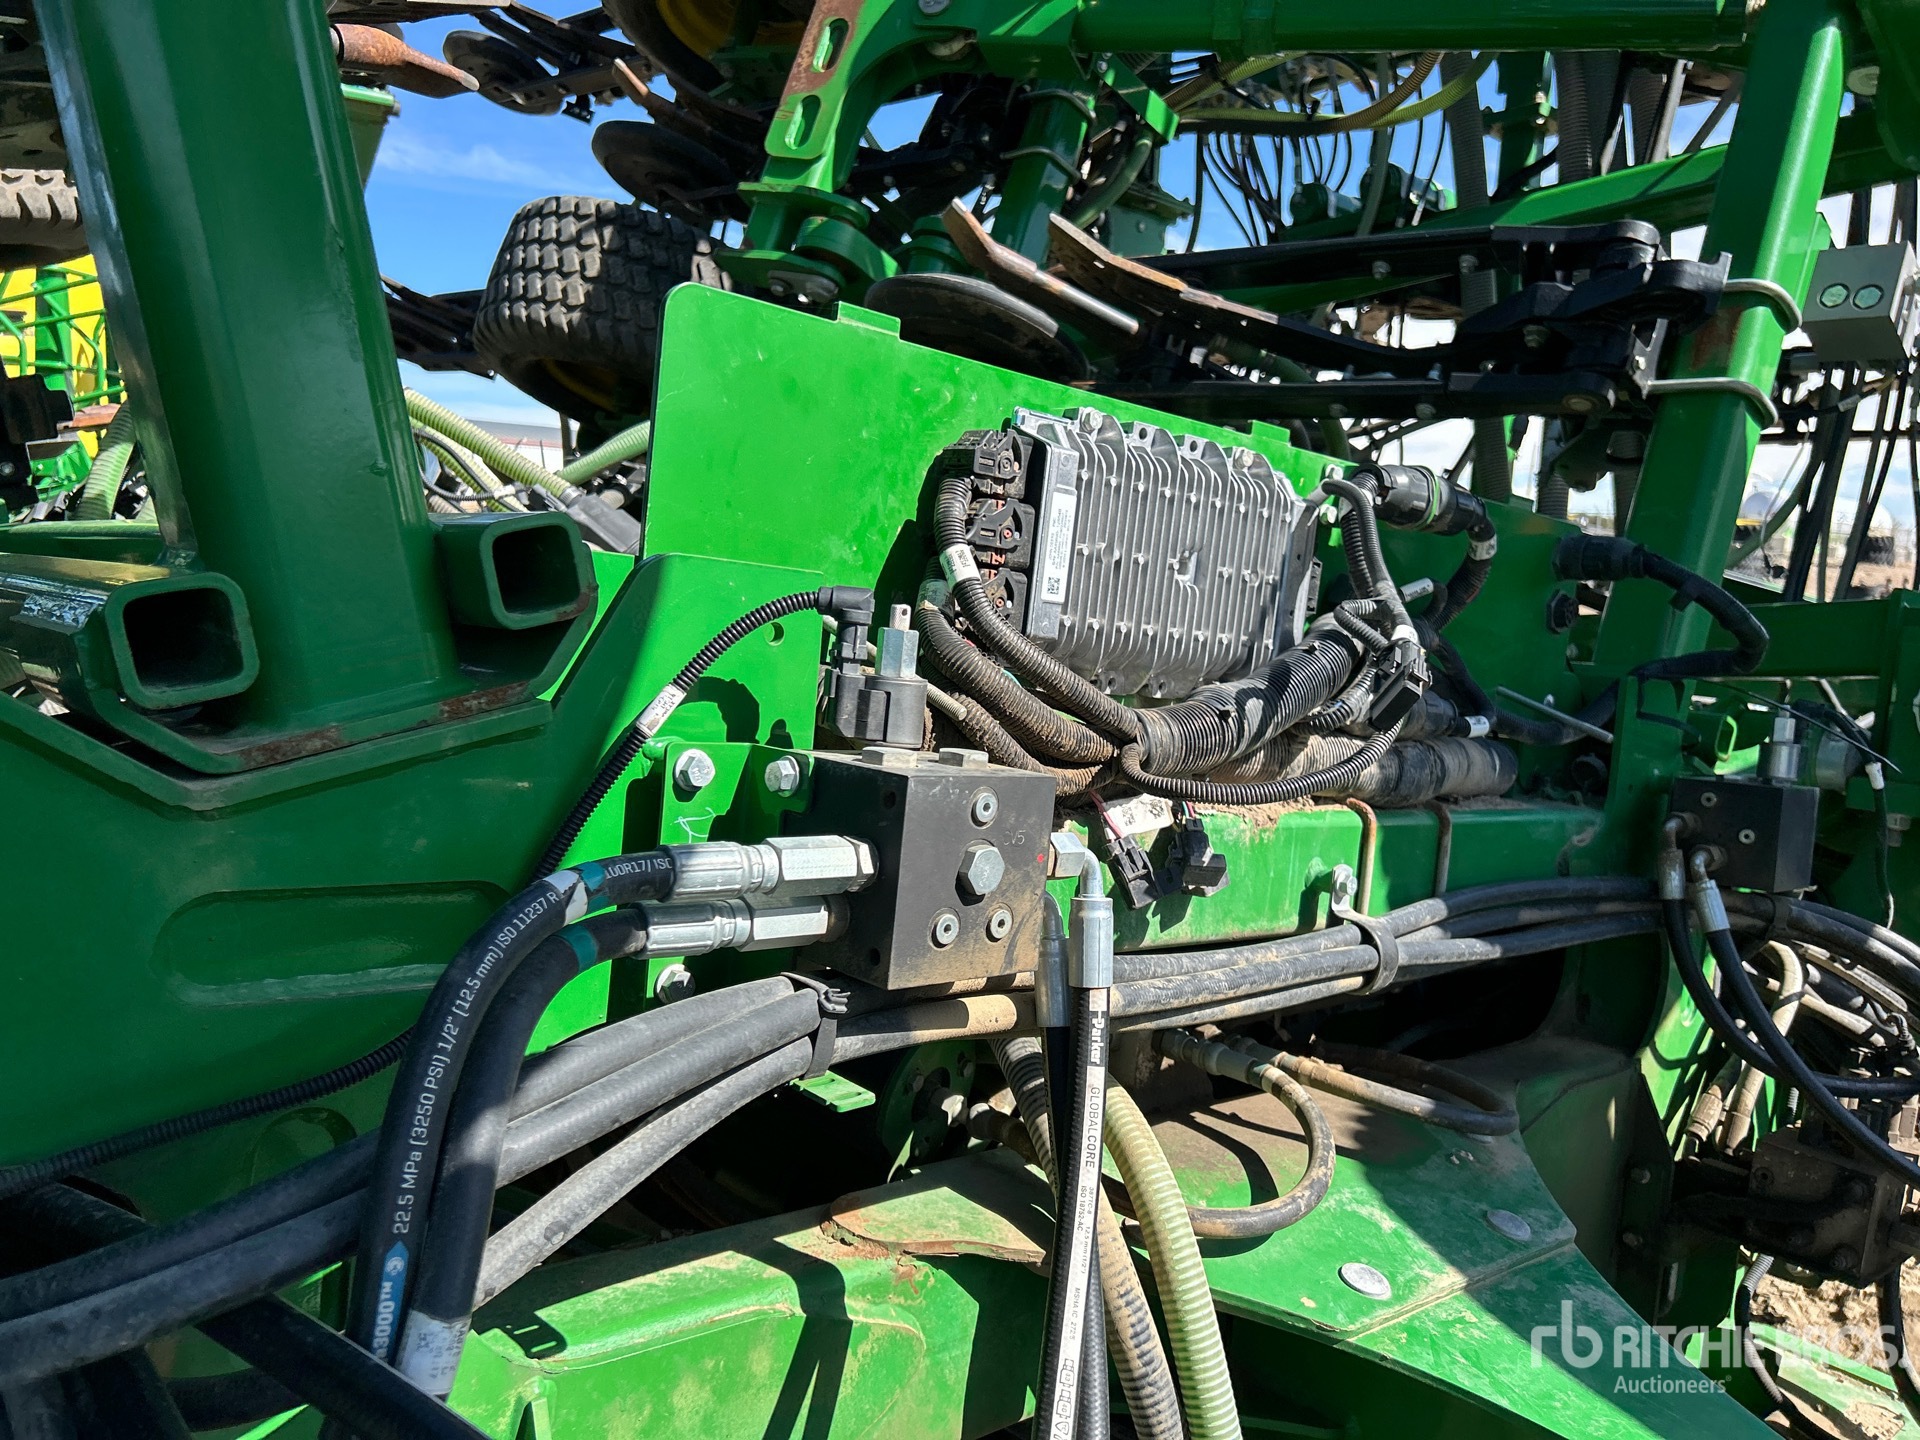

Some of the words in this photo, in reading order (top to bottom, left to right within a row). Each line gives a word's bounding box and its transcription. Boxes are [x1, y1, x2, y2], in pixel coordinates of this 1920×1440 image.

[513, 897, 549, 931] 11237
[547, 890, 565, 904] R
[494, 926, 518, 949] ISO
[476, 945, 504, 979] mm)
[452, 977, 481, 1018] (12.5
[438, 1016, 460, 1052] 1/2"
[1091, 1018, 1105, 1065] Parker
[424, 1055, 451, 1090] PSI)
[410, 1093, 436, 1146] (3250
[1085, 1087, 1101, 1169] GLOBALCORE
[401, 1151, 422, 1189] MPa
[1080, 1185, 1088, 1199] ISO
[393, 1194, 415, 1234] 22.5
[1077, 1199, 1086, 1231] 18752-AC
